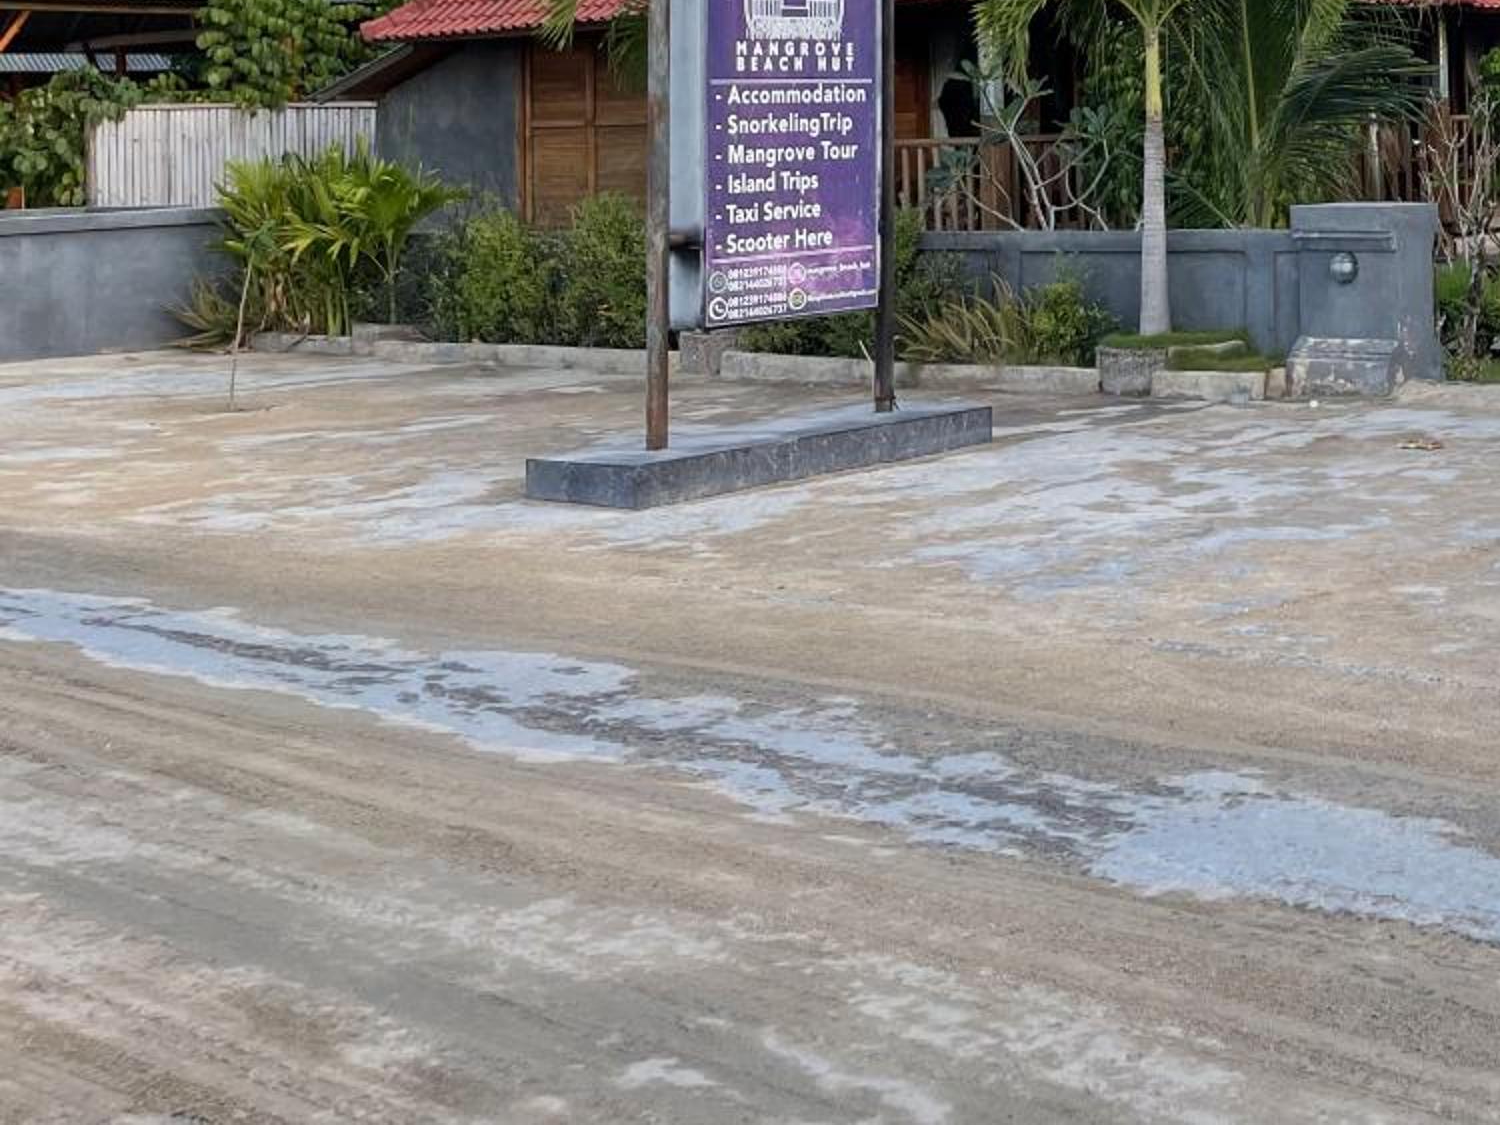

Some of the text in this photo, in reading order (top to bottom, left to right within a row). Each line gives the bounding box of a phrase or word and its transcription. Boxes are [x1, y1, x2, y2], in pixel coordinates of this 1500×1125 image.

[736, 40, 855, 56] MANGROVE
[736, 56, 855, 71] BEACH HUT
[727, 83, 867, 105] Accommodation
[727, 144, 816, 167] Mangrove
[820, 140, 859, 160] Tour
[727, 170, 776, 194] Island
[780, 170, 819, 195] Trips
[726, 201, 759, 224] Taxi
[763, 198, 821, 222] Service
[726, 232, 791, 254] Scooter
[795, 228, 833, 248] Here
